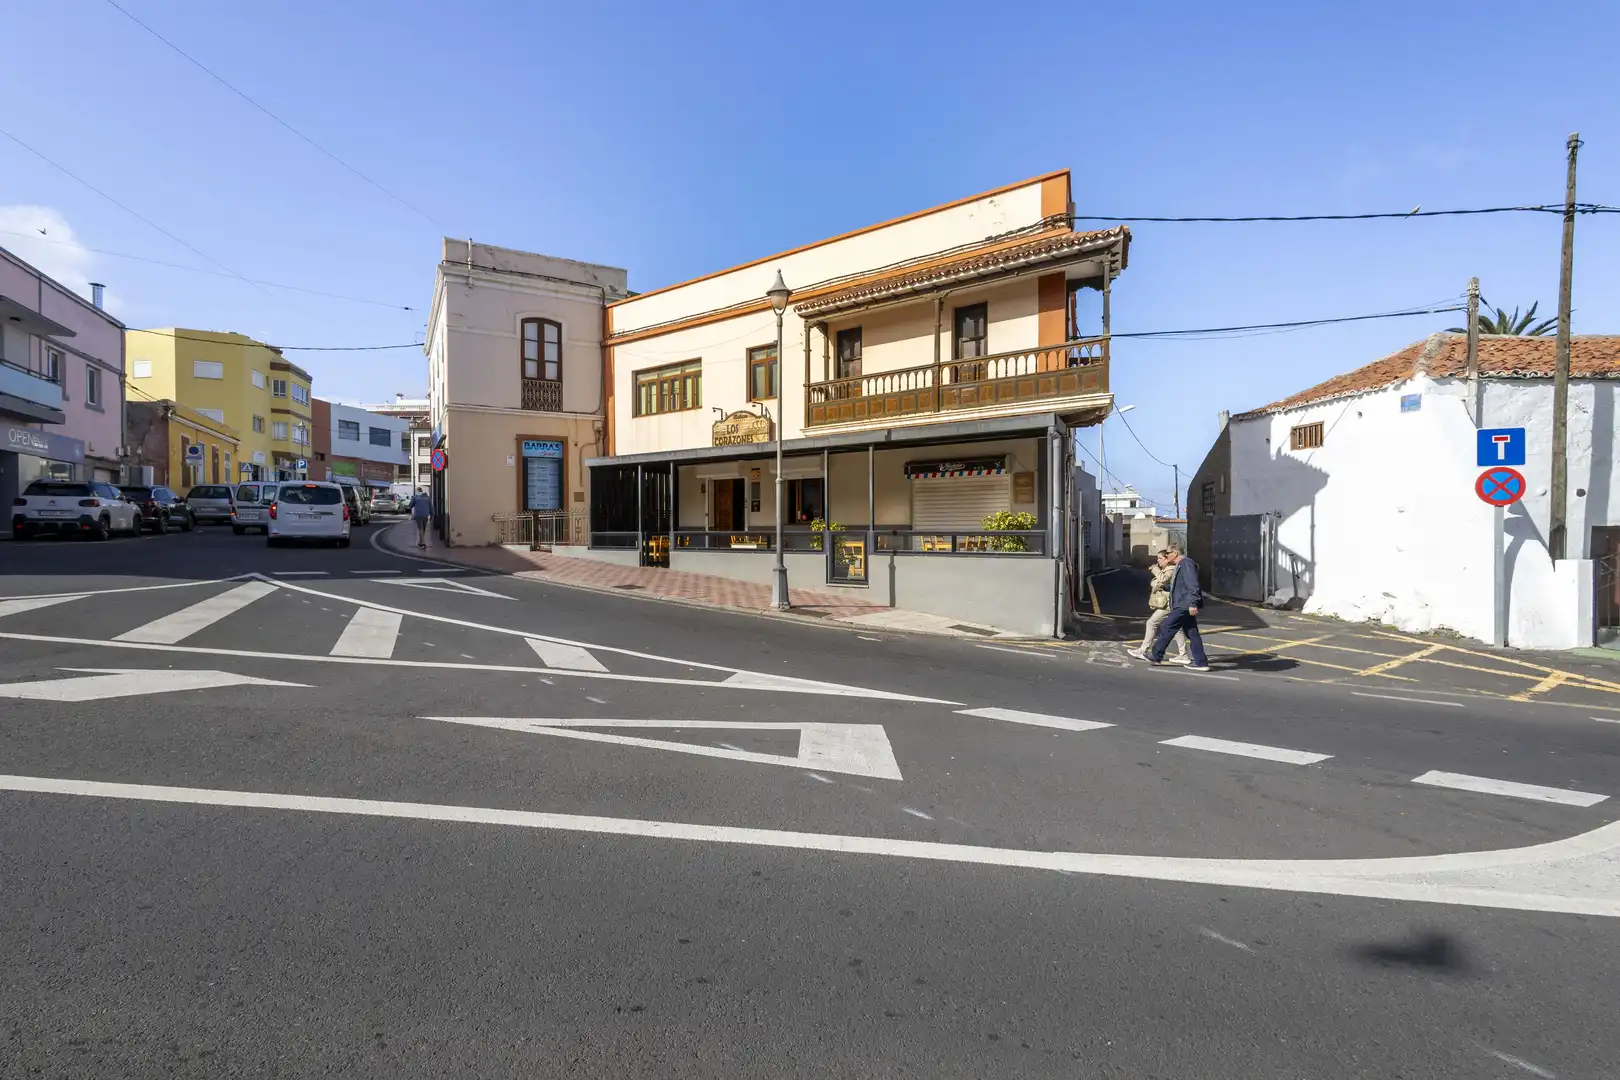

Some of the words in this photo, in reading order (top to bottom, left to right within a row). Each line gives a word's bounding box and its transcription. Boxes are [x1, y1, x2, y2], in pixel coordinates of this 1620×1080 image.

[726, 423, 739, 435] LOS
[8, 428, 34, 445] OPEN
[714, 434, 754, 446] CORAZONES
[524, 442, 560, 451] BARRA'S
